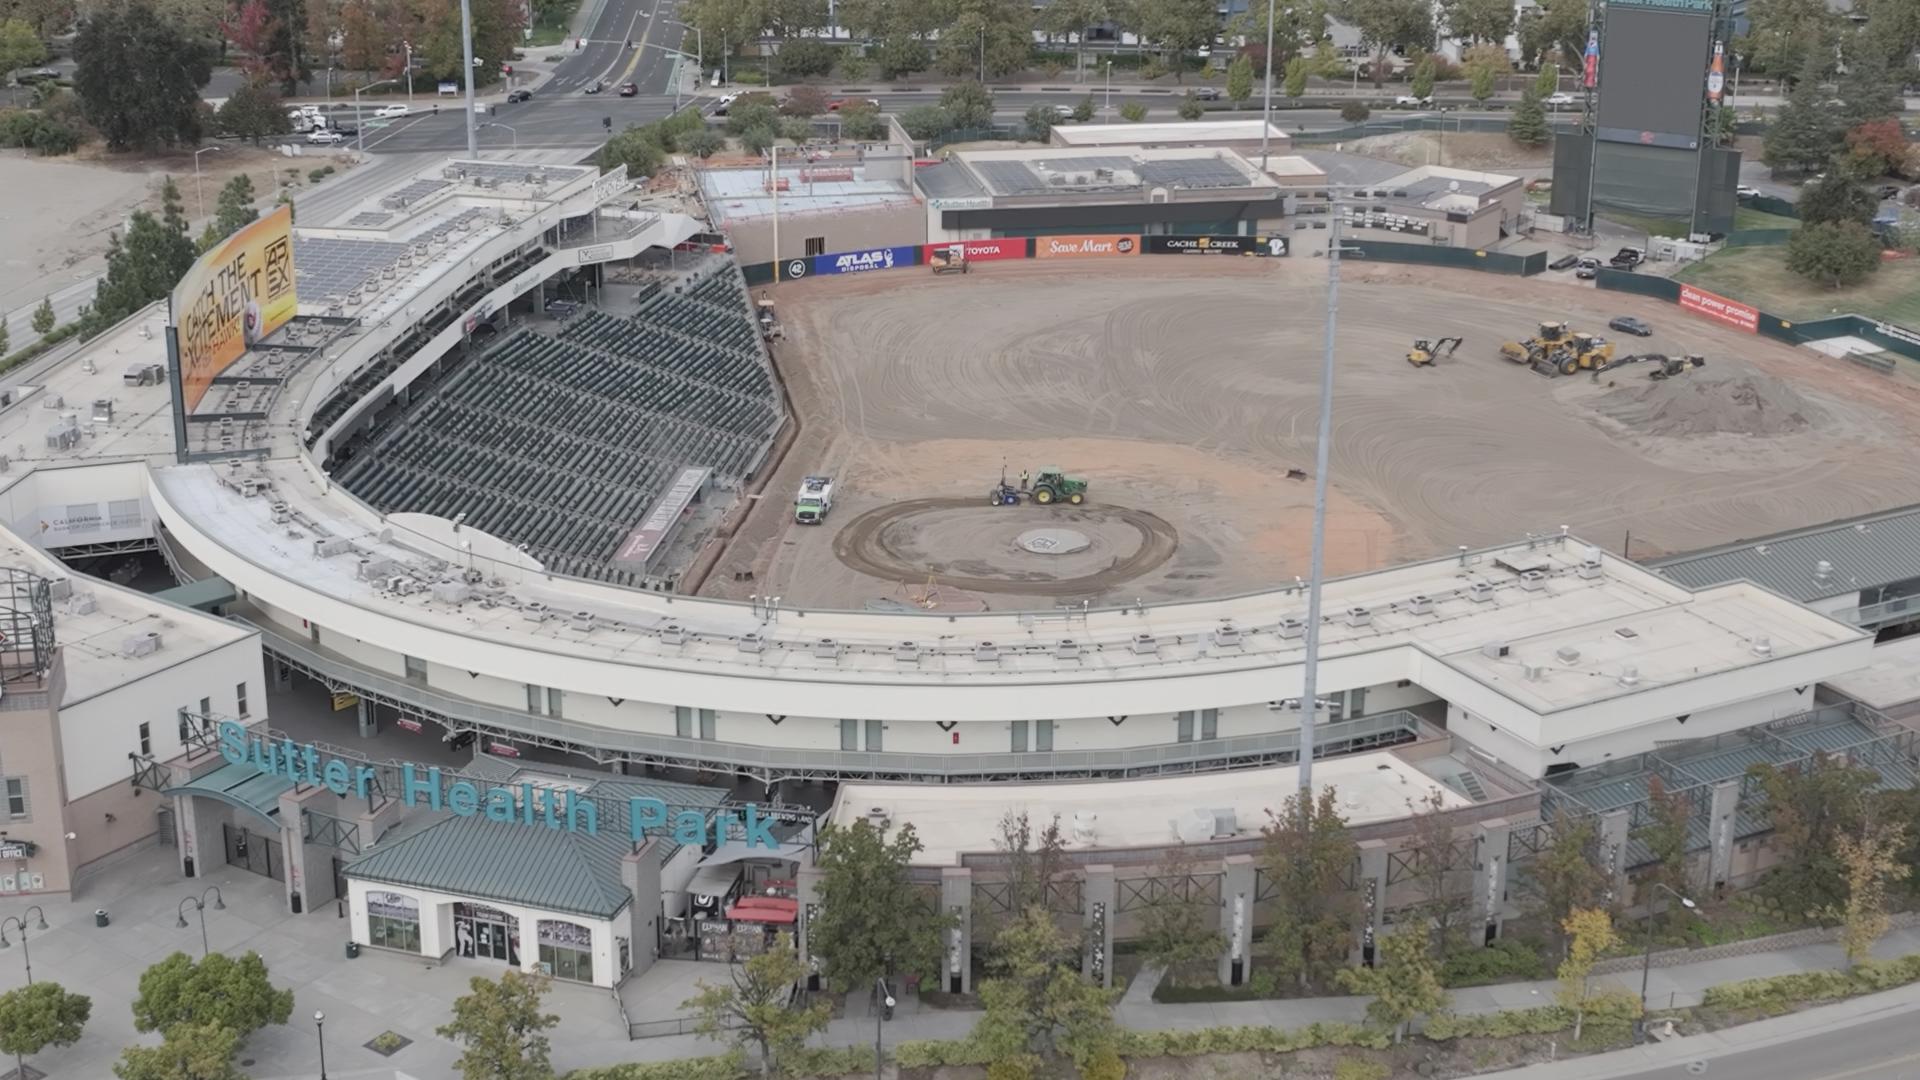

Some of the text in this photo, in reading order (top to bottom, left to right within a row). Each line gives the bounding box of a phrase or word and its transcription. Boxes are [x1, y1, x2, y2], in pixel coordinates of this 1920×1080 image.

[967, 246, 1001, 255] TOYOTA
[1050, 240, 1078, 254] Save
[1080, 239, 1113, 252] Mart
[1167, 240, 1239, 248] CACHE CREEK
[836, 251, 884, 267] ATLAS
[217, 252, 247, 296] THE
[792, 264, 802, 274] 42
[841, 263, 879, 272] DISPOSAL
[1701, 297, 1726, 310] power
[184, 268, 262, 369] XCITEMENT
[53, 516, 102, 526] CALIFORNIA
[218, 720, 780, 849] Sutter Health Park
